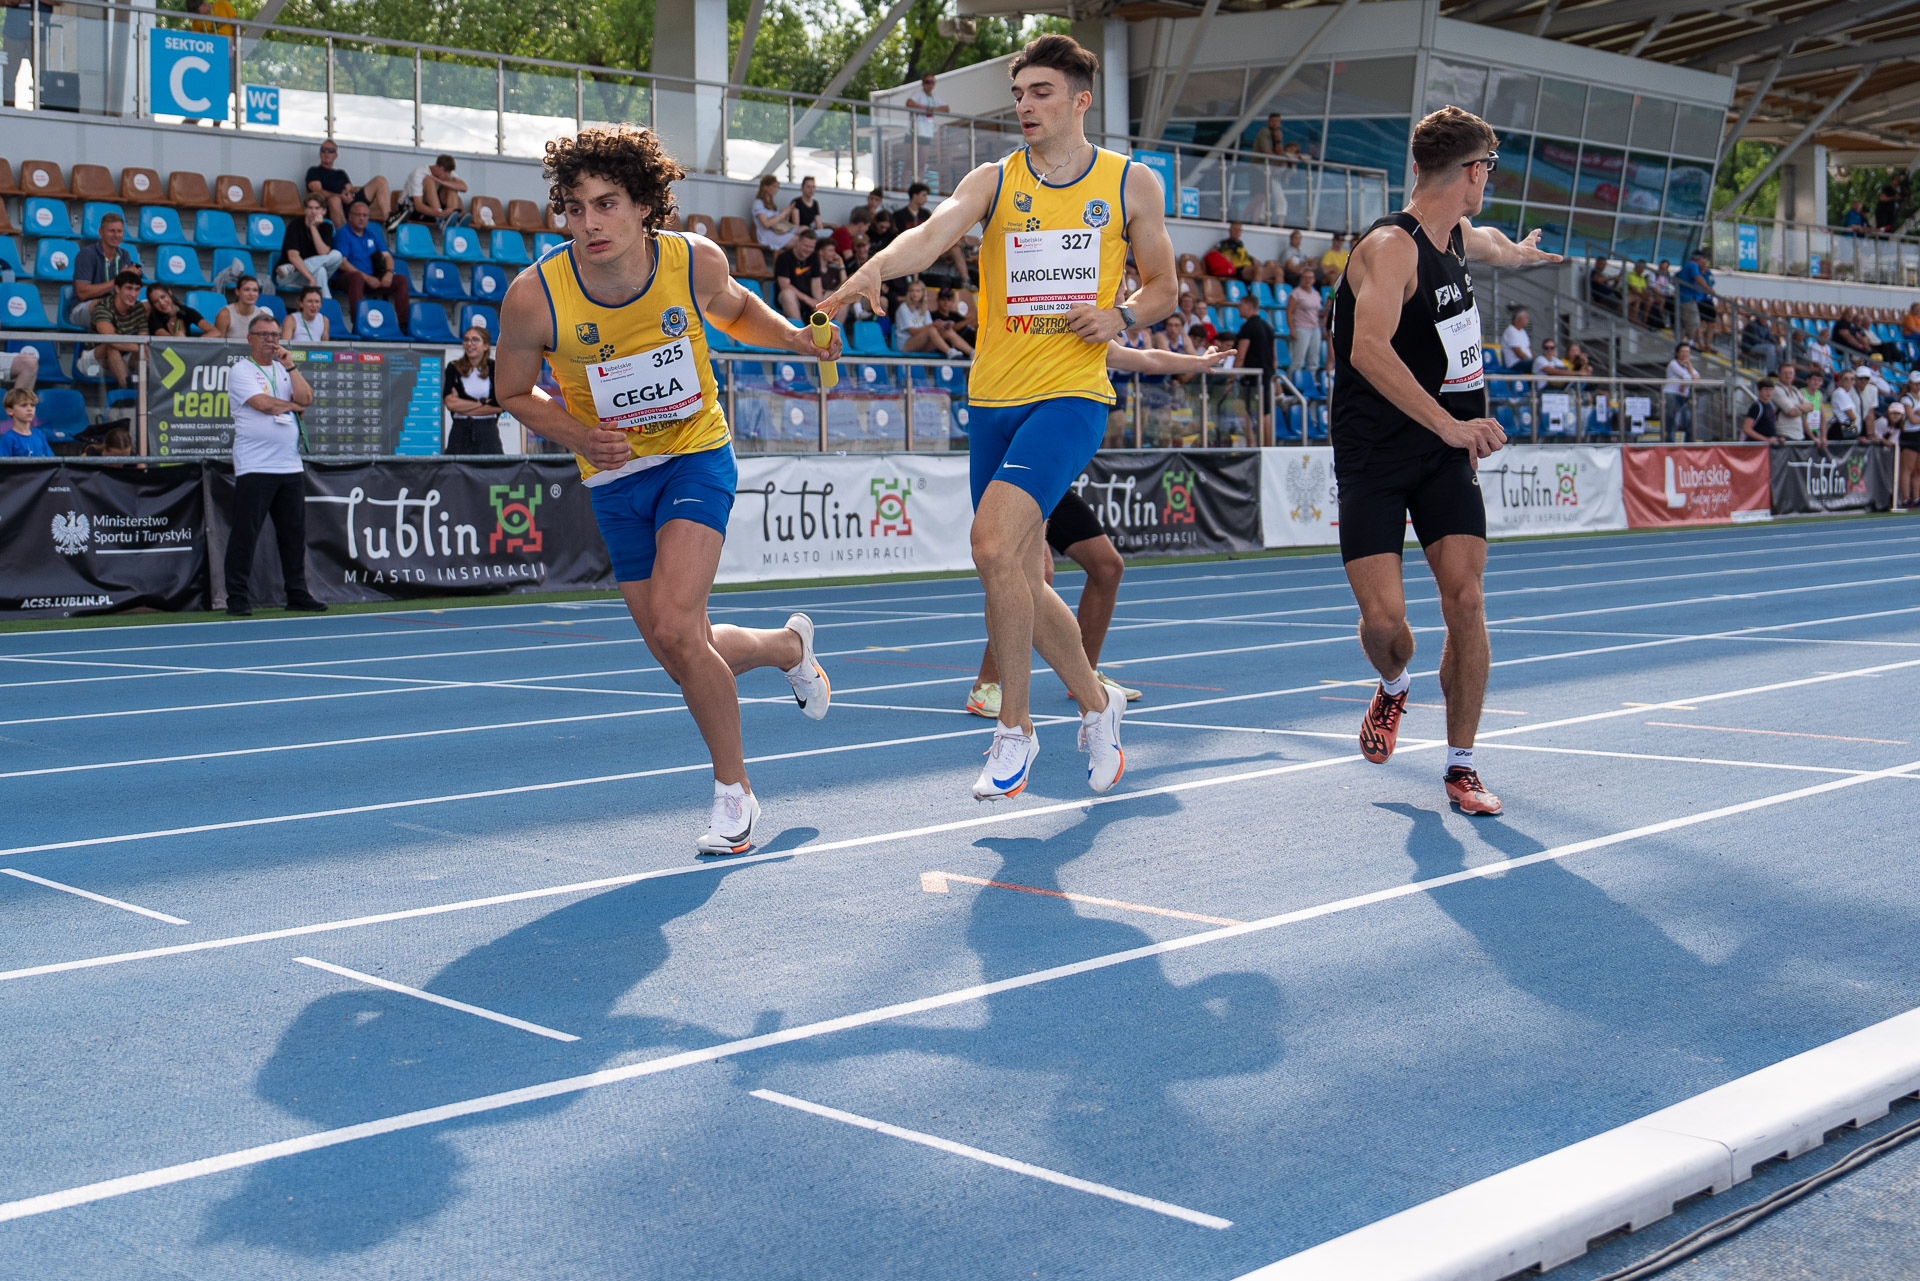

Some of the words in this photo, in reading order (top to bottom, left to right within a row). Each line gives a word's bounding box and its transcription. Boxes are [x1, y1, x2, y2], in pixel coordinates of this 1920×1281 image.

[165, 37, 214, 54] SEKTOR
[169, 56, 211, 112] C
[248, 90, 278, 110] WC
[1061, 233, 1092, 251] 327
[1011, 267, 1096, 283] KAROLEWSKI
[1030, 303, 1055, 311] LUBLIN
[652, 343, 684, 368] 325
[613, 377, 684, 408] CEGŁA
[630, 415, 657, 425] LUBLIN
[658, 411, 678, 419] 2024
[93, 515, 168, 527] Ministerstwo
[94, 531, 132, 544] Sportu
[135, 530, 139, 542] i
[143, 528, 192, 543] Turystyki
[1131, 531, 1197, 544] INSPIRACJI
[763, 551, 820, 564] MIASTO
[831, 546, 913, 561] INSPIRACJI
[344, 567, 426, 584] MIASTO
[437, 562, 545, 580] INSPIRACJI
[21, 595, 113, 609] ACSS.LUBLIN.PL
